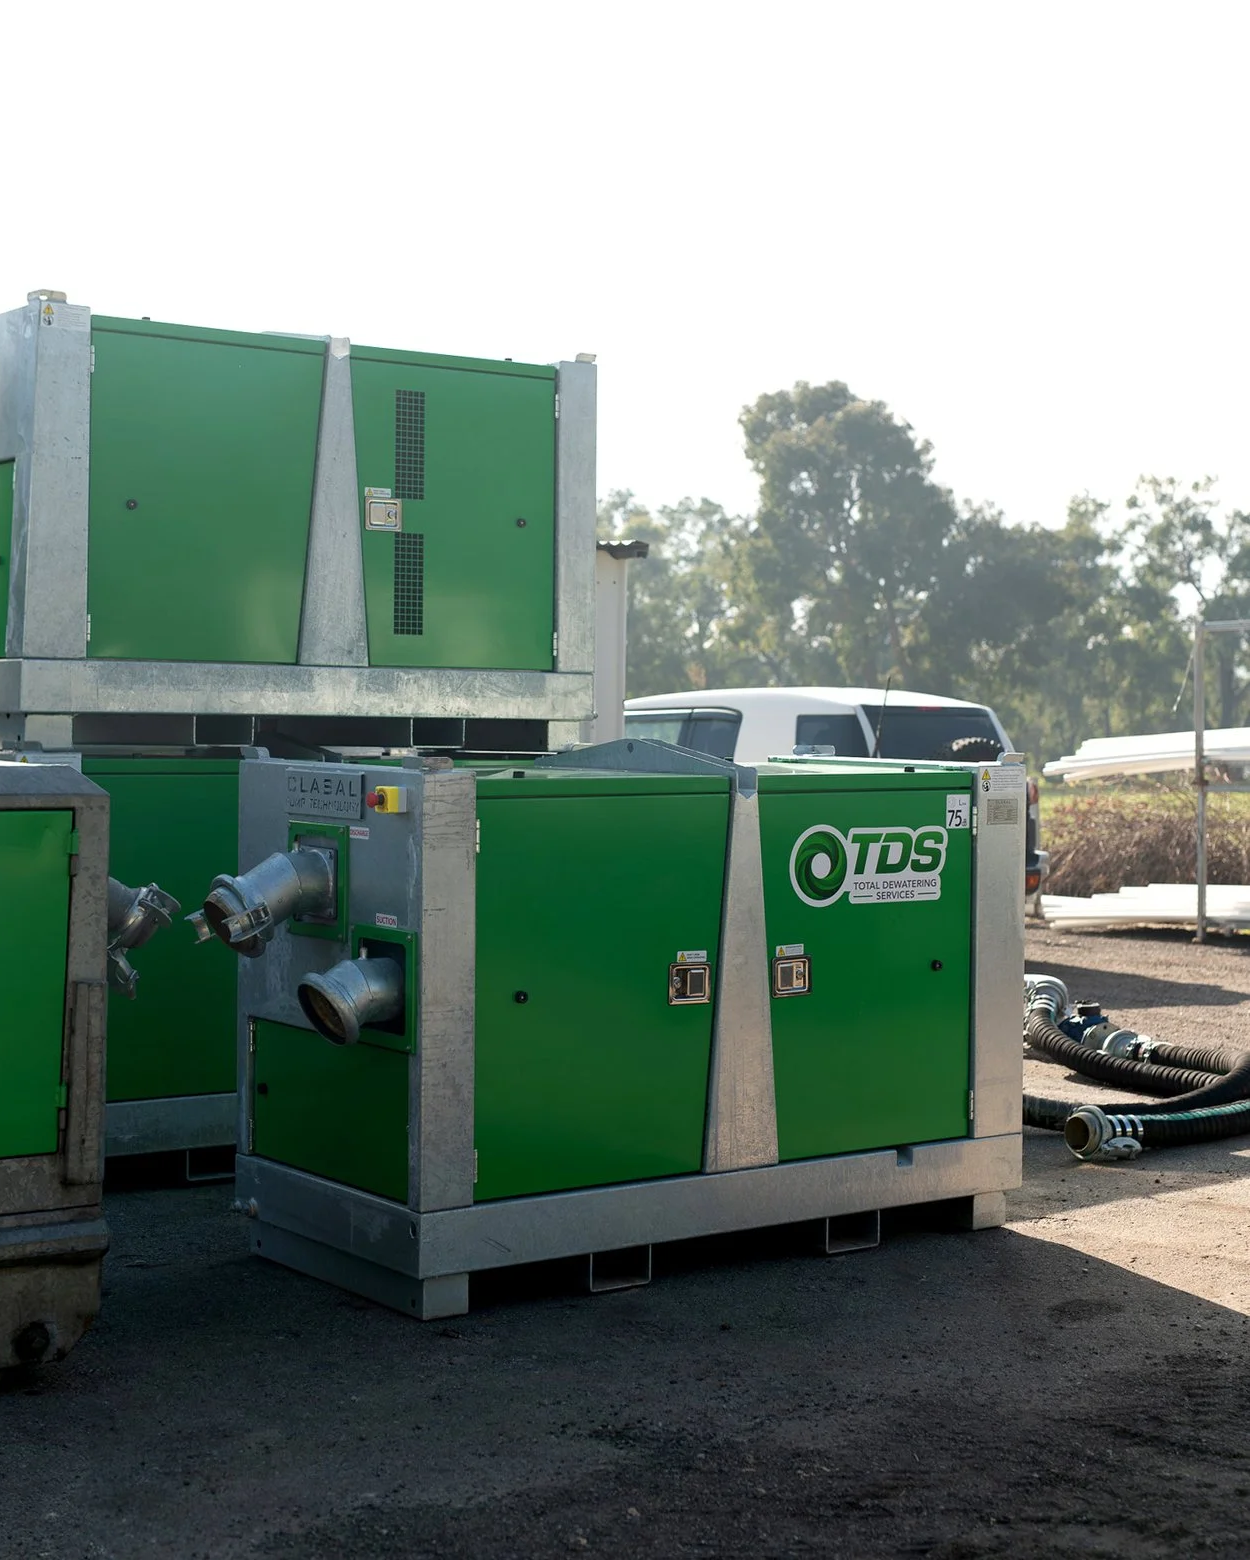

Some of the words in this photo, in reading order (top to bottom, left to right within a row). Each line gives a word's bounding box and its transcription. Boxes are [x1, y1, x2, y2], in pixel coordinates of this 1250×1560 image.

[948, 810, 962, 827] 75
[851, 831, 944, 874] TDS
[854, 880, 880, 890] TOTAL
[882, 879, 937, 889] DEWATERING
[876, 890, 915, 900] SERVICES
[377, 916, 396, 926] SUCTION
